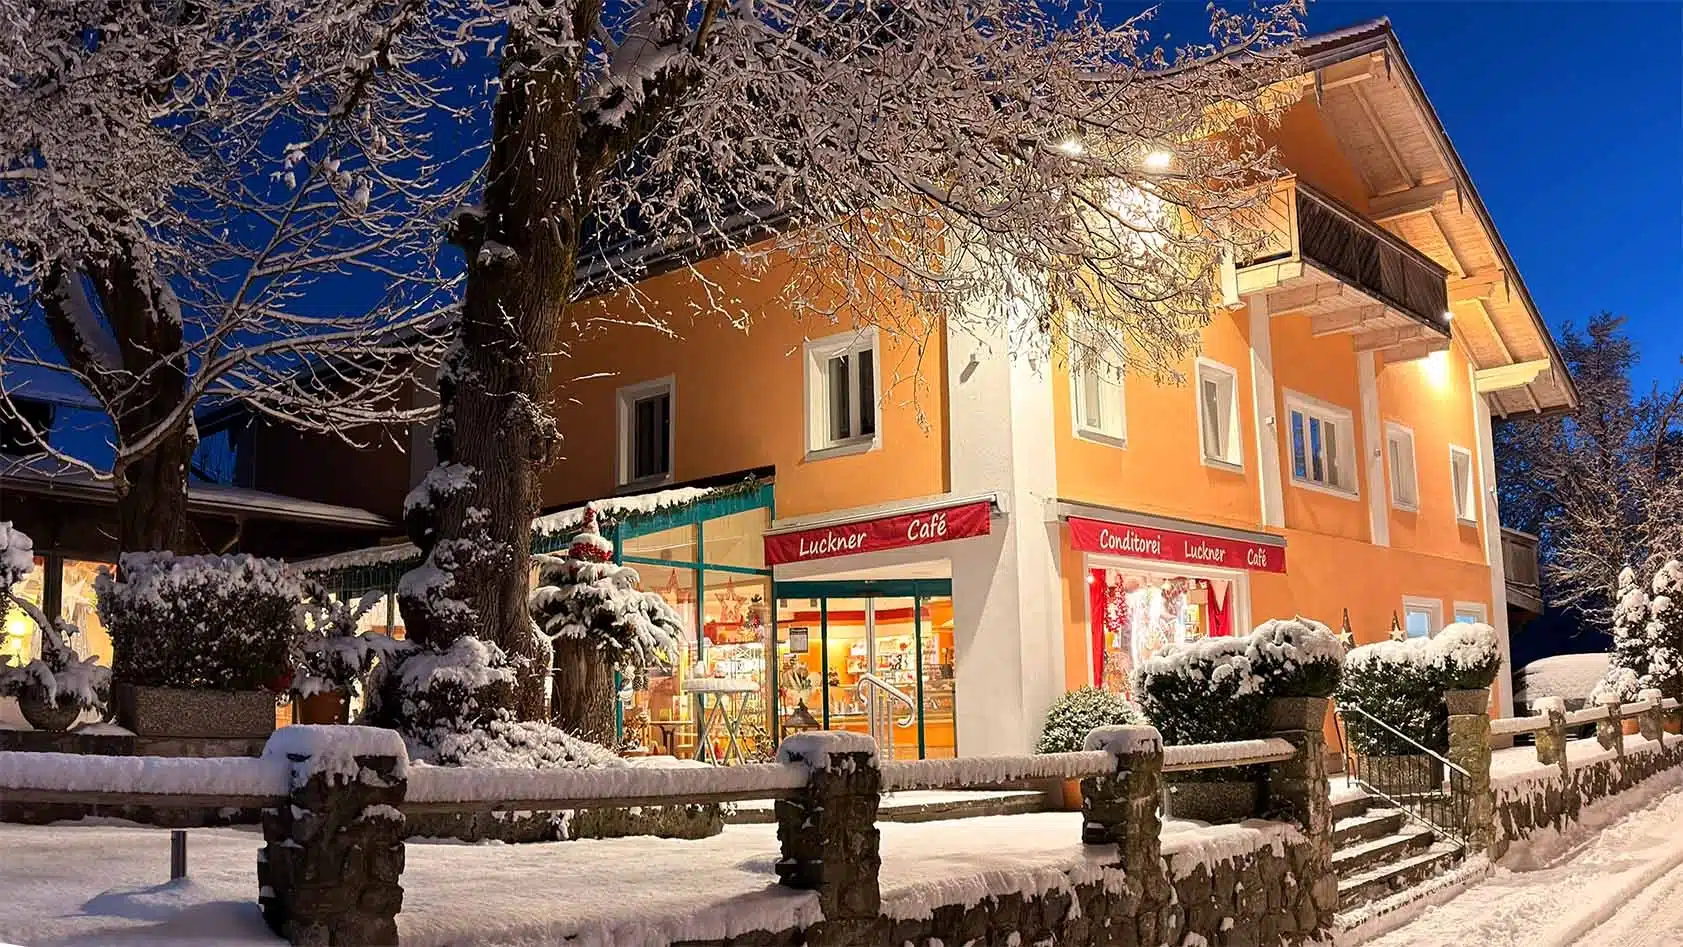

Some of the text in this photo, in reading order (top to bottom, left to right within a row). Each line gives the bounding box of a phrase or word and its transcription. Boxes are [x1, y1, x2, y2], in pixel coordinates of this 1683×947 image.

[799, 512, 947, 557] Luckner Café
[1100, 528, 1267, 567] Conditorei Luckner Café
